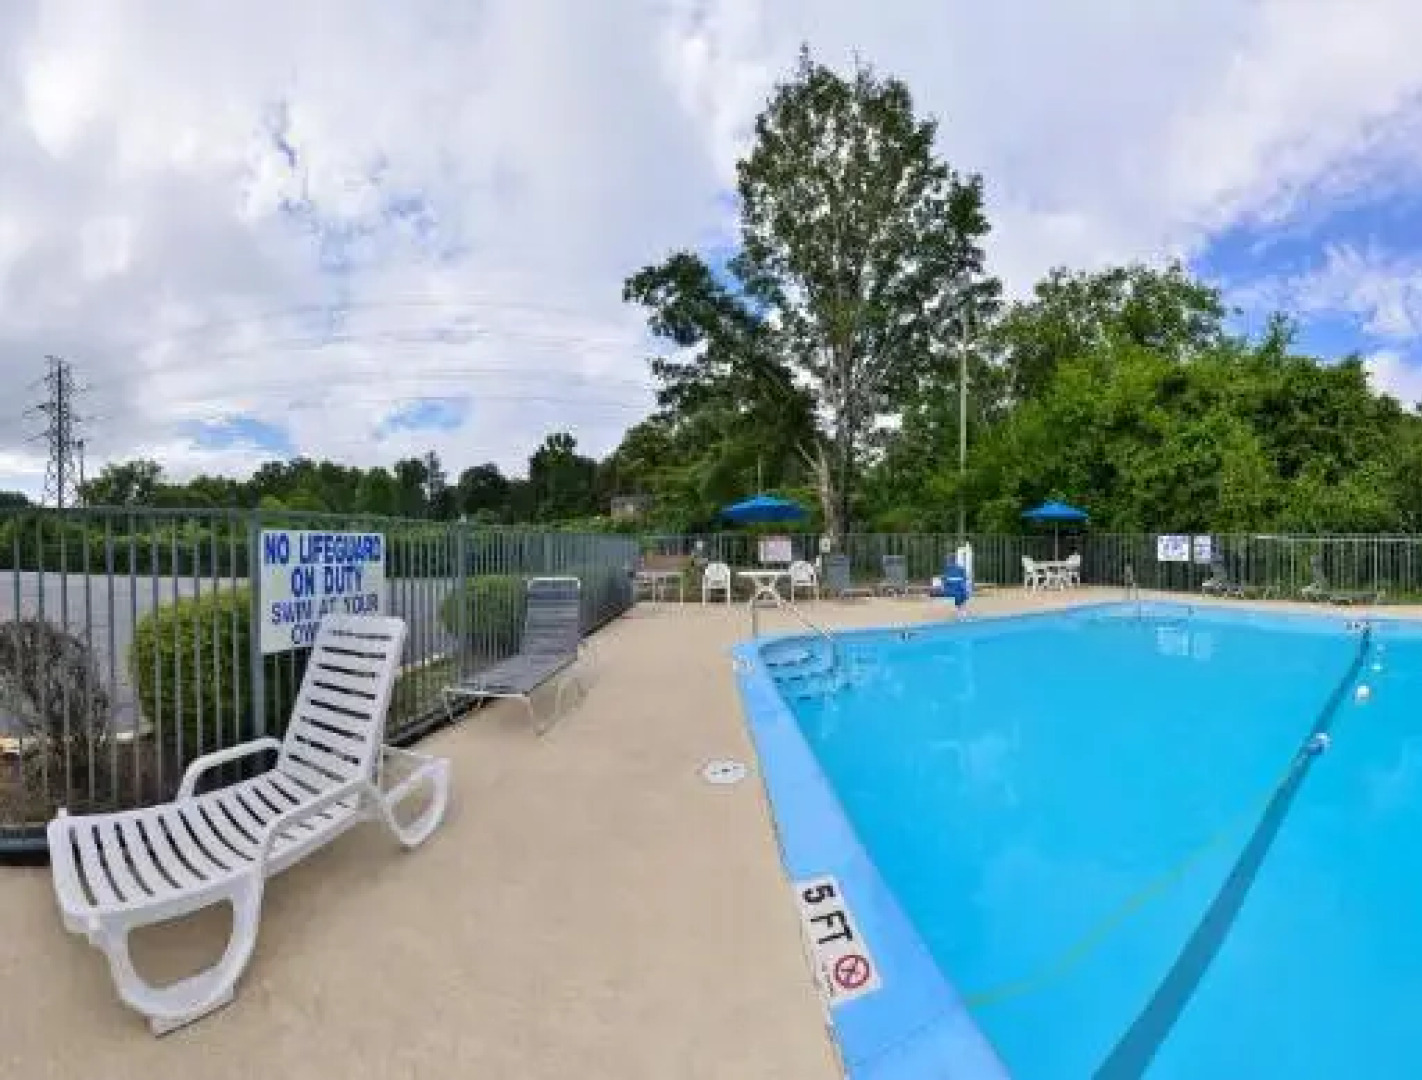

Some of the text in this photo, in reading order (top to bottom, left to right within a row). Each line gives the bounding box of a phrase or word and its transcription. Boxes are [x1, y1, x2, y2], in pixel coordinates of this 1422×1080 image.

[265, 532, 382, 565] NO LIFEGUARD
[291, 566, 363, 598] ON DUTY
[271, 594, 379, 625] SWIM AT YOUR
[291, 621, 320, 645] OW
[802, 884, 836, 904] 5
[810, 910, 854, 945] FT
